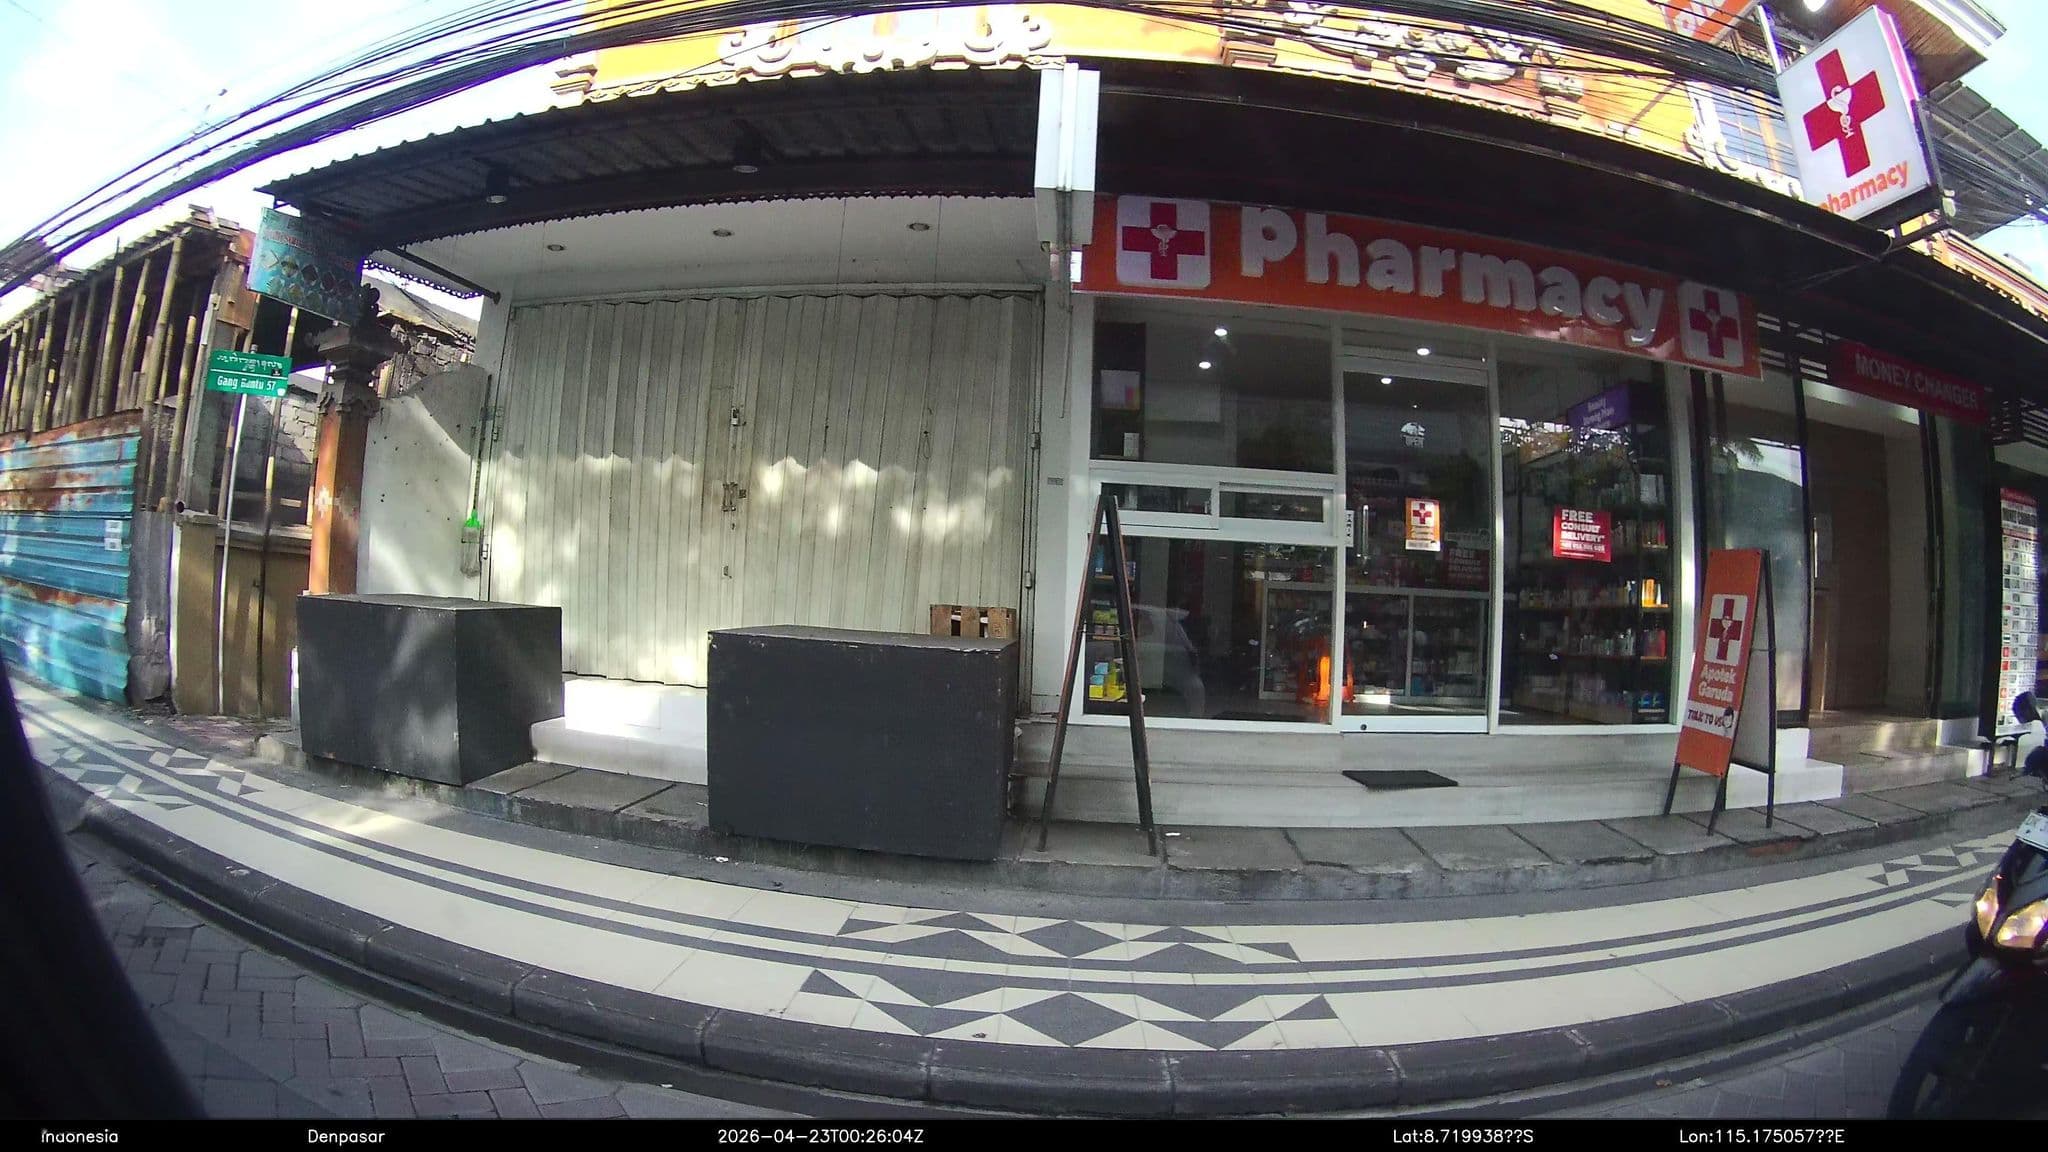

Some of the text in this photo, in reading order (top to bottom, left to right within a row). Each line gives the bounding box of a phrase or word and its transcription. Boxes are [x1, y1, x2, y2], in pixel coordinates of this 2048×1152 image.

[217, 375, 238, 390] Gang
[266, 380, 276, 391] 57
[1855, 352, 1979, 410] MONEY CHANGER
[1561, 509, 1594, 523] FREE
[1561, 522, 1601, 533] CONSULT
[1701, 664, 1736, 684] Apotek
[1699, 681, 1733, 703] Garuda
